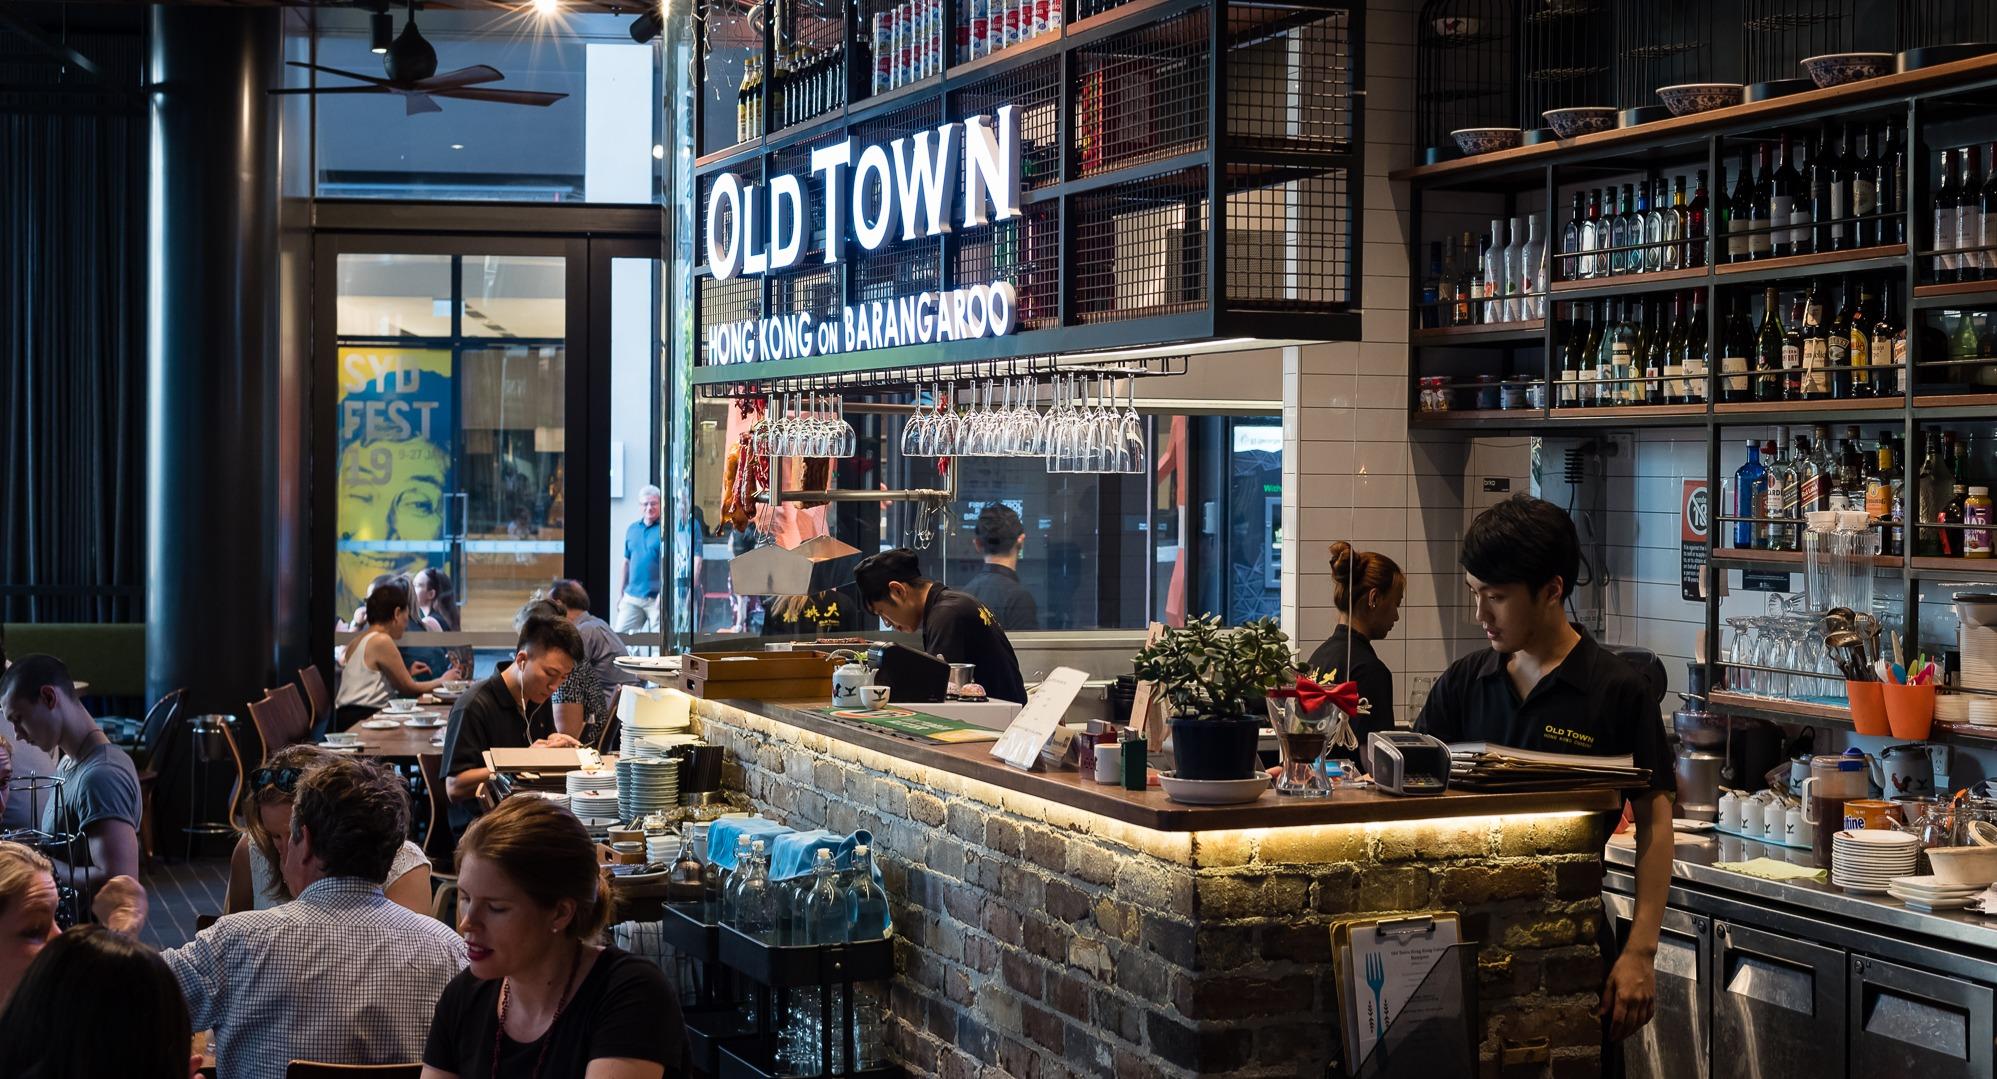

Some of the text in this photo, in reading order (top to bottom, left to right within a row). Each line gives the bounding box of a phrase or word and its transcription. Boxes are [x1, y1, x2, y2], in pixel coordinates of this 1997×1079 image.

[707, 105, 1019, 280] OLD TOWN
[708, 281, 1012, 366] HONG KONG ON BARANGAROO
[344, 354, 420, 393] SYD
[344, 400, 439, 440] FEST
[345, 447, 393, 486] 19
[1545, 725, 1594, 743] OLD TOWN
